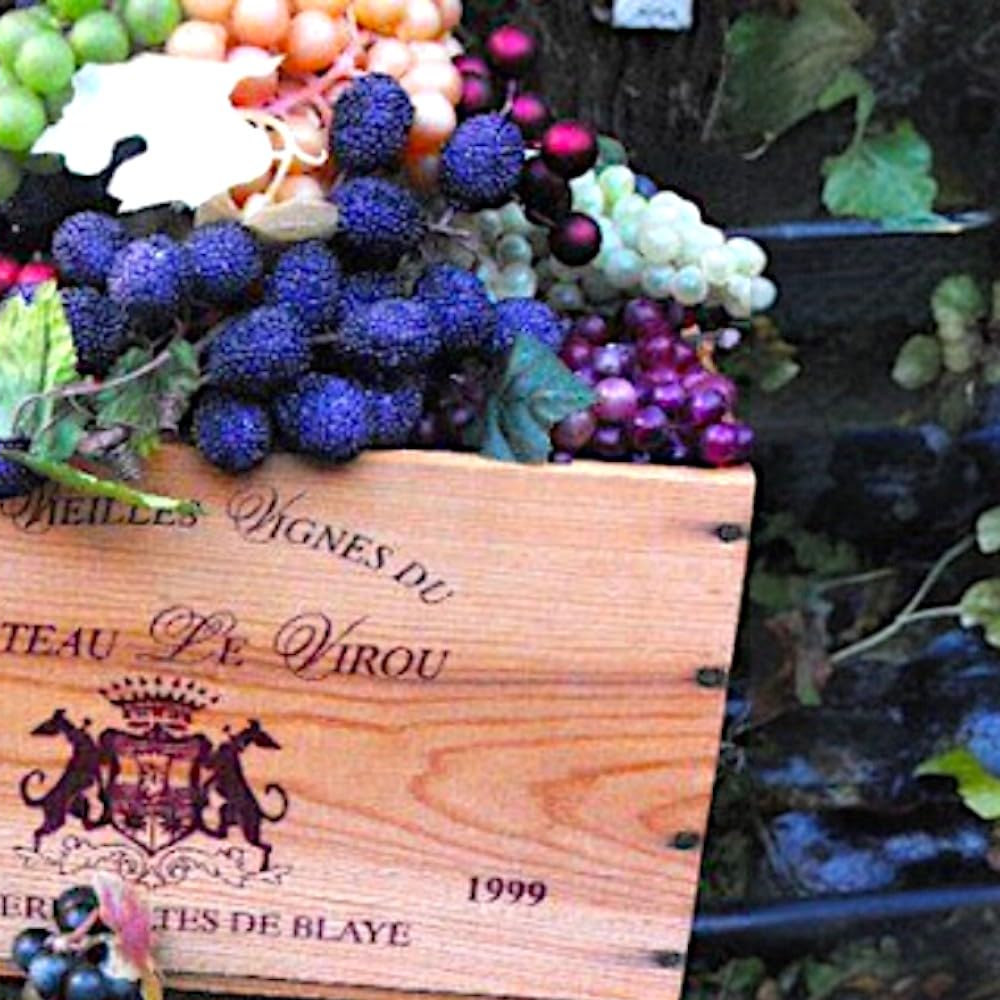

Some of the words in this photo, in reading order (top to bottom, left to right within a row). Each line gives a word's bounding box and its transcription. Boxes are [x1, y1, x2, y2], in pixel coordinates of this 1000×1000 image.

[227, 485, 399, 571] VIGNES
[394, 559, 455, 605] DU
[273, 610, 450, 681] VIROU
[468, 875, 547, 907] 1999
[150, 905, 220, 935] TES
[229, 910, 281, 939] DE
[292, 916, 412, 949] BLAYE
